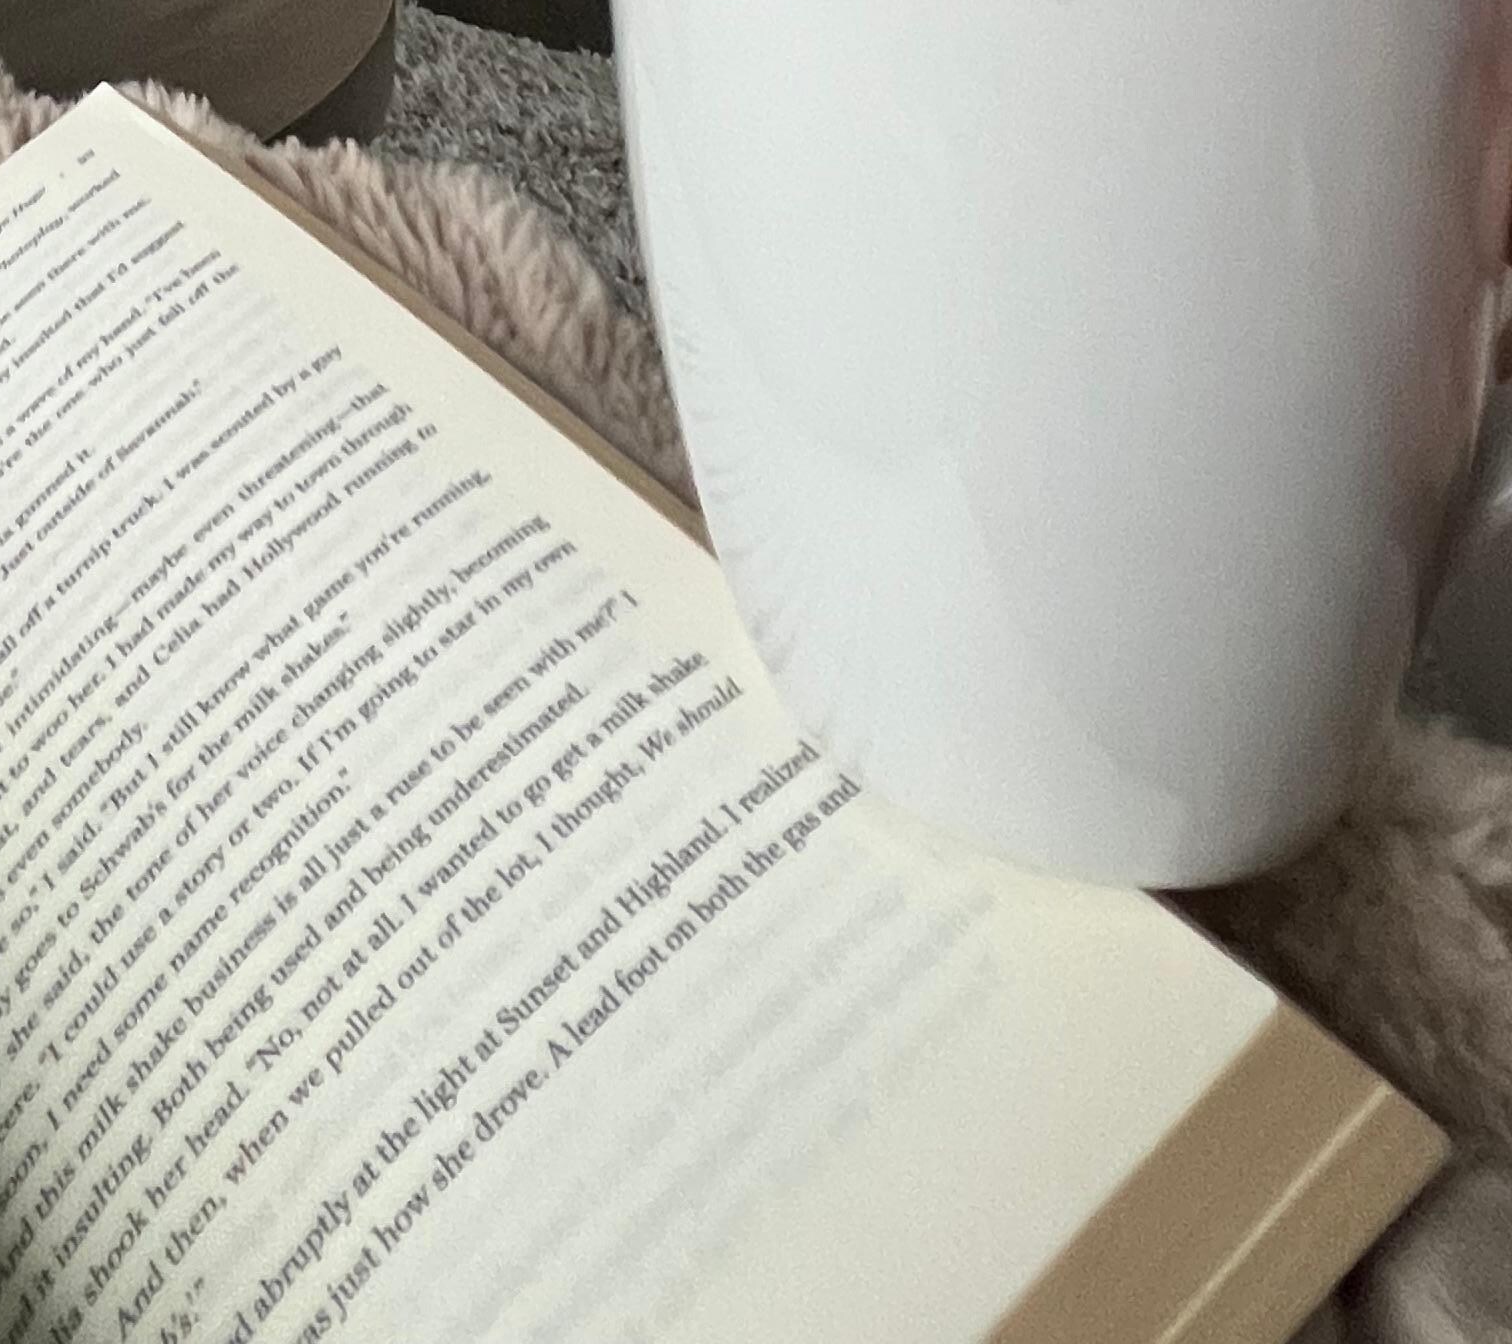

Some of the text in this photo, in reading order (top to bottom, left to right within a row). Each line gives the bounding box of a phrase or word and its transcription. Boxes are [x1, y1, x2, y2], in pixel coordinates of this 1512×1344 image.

[5, 514, 551, 1062] she said, the tone of her voice changing slightly, becoming
[21, 766, 57, 817] and
[114, 663, 151, 708] and
[151, 617, 202, 666] Celia
[200, 577, 241, 617] had
[240, 490, 342, 581] Hollywood
[34, 1161, 75, 1221] this
[76, 1093, 124, 1162] milk
[125, 1015, 187, 1095] shake
[182, 911, 277, 1017] business
[272, 891, 298, 915] is
[298, 854, 327, 893] all
[323, 817, 370, 869] just
[384, 758, 431, 806] ruse
[429, 739, 456, 762] to
[449, 714, 484, 742] be
[482, 675, 532, 716] seen
[527, 637, 577, 676] with
[31, 681, 590, 1301] it insulting. Both being used and being underestimated.
[62, 1036, 112, 1112] need
[113, 972, 168, 1044] some
[169, 903, 228, 973] name
[83, 1210, 149, 1306] shook
[143, 1154, 187, 1210] her
[183, 1080, 250, 1158] head.
[299, 975, 343, 1022] not
[341, 947, 368, 978] at
[417, 815, 499, 896] wanted
[494, 799, 523, 824] to
[522, 774, 551, 807] go
[550, 742, 588, 782] get
[598, 691, 650, 735] milk
[646, 652, 704, 696] shake
[117, 1258, 164, 1340] And
[164, 1196, 227, 1266] then,
[224, 1109, 289, 1184] when
[287, 1066, 324, 1105] we
[324, 982, 397, 1075] pulled
[396, 946, 437, 989] out
[437, 912, 462, 949] of
[459, 884, 502, 923] the
[494, 853, 543, 889] lot,
[550, 761, 646, 838] thought,
[636, 729, 672, 761] We
[675, 675, 743, 735] should
[253, 1189, 352, 1322] abruptly
[351, 1160, 380, 1197] at
[374, 1116, 420, 1164] the
[411, 1055, 477, 1122] light
[473, 1028, 503, 1062] at
[495, 953, 580, 1036] Sunset
[576, 906, 623, 960] and
[614, 816, 728, 917] Highland.
[737, 739, 821, 814] realized
[326, 1245, 381, 1324] just
[370, 1183, 430, 1253] how
[431, 1139, 474, 1191] she
[472, 1069, 549, 1142] drove.
[560, 984, 621, 1046] lead
[613, 945, 668, 996] foot
[664, 918, 698, 952] on
[686, 873, 750, 923] both
[741, 841, 786, 877] the
[781, 811, 821, 853] gas
[817, 772, 862, 816] and
